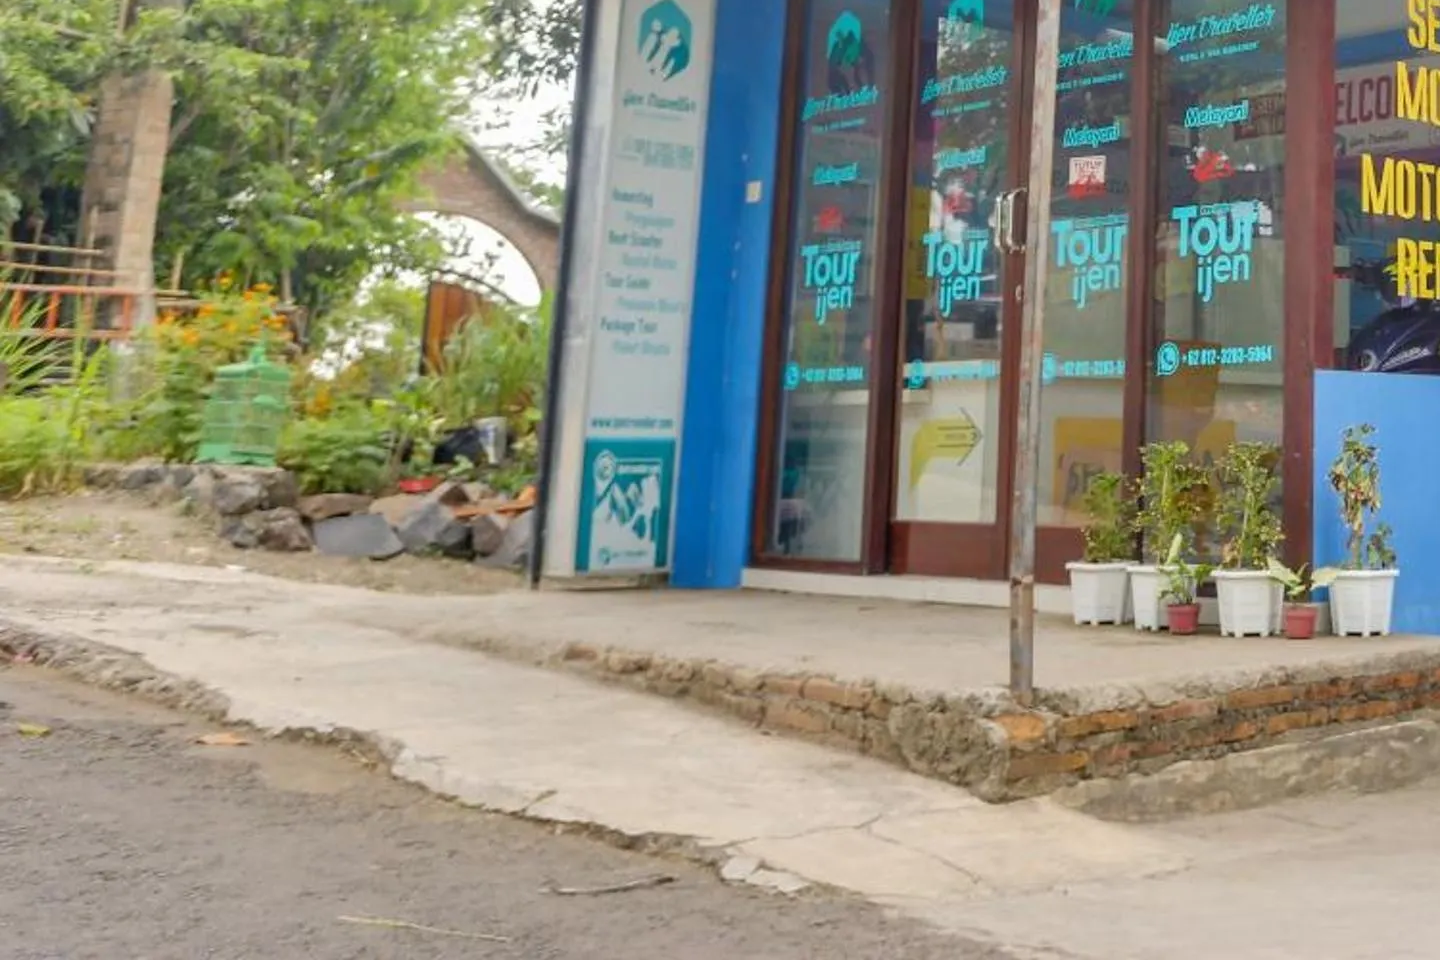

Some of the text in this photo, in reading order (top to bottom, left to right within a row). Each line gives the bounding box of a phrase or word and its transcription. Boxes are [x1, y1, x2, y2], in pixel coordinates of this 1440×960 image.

[1051, 218, 1128, 268] Tour
[1171, 204, 1258, 257] Tour
[801, 244, 860, 288] Tour
[923, 230, 989, 278] Tour
[939, 274, 981, 318] ijen
[1072, 264, 1120, 309] ijen
[1197, 253, 1250, 303] ijen
[815, 285, 853, 326] ijen
